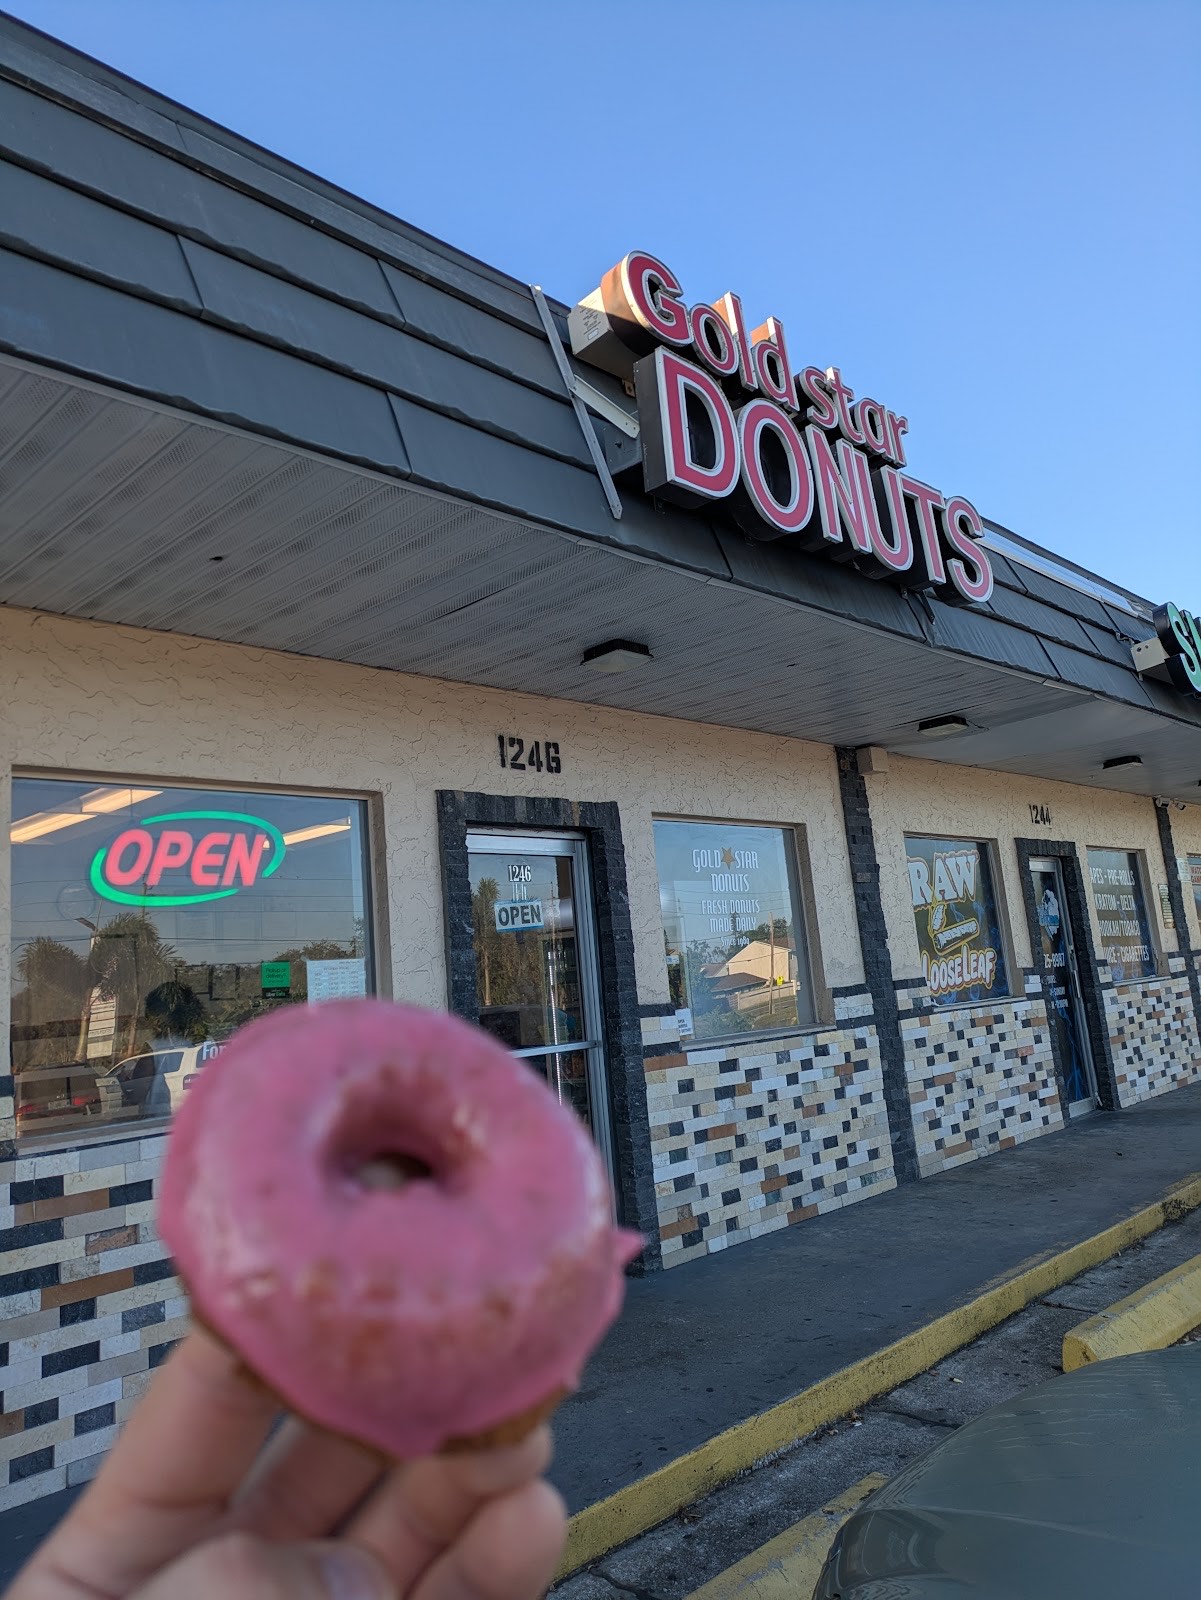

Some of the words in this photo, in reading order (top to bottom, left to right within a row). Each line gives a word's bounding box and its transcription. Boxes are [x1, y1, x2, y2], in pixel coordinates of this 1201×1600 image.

[621, 250, 799, 412] Gold
[799, 366, 908, 467] star
[655, 345, 994, 602] DONUTS
[498, 734, 562, 774] 1246
[1028, 803, 1051, 825] 1244
[105, 829, 267, 886] OPEN
[692, 849, 721, 872] GOLD
[734, 850, 759, 869] STAR
[508, 864, 532, 883] 1246
[711, 873, 749, 892] DONUTS
[906, 851, 979, 910] RAW
[1089, 867, 1104, 884] APES
[498, 904, 542, 926] OPEN
[702, 900, 728, 914] FRESH
[730, 899, 760, 914] DONUTS
[710, 918, 734, 933] MADE
[736, 916, 756, 931] DAILY
